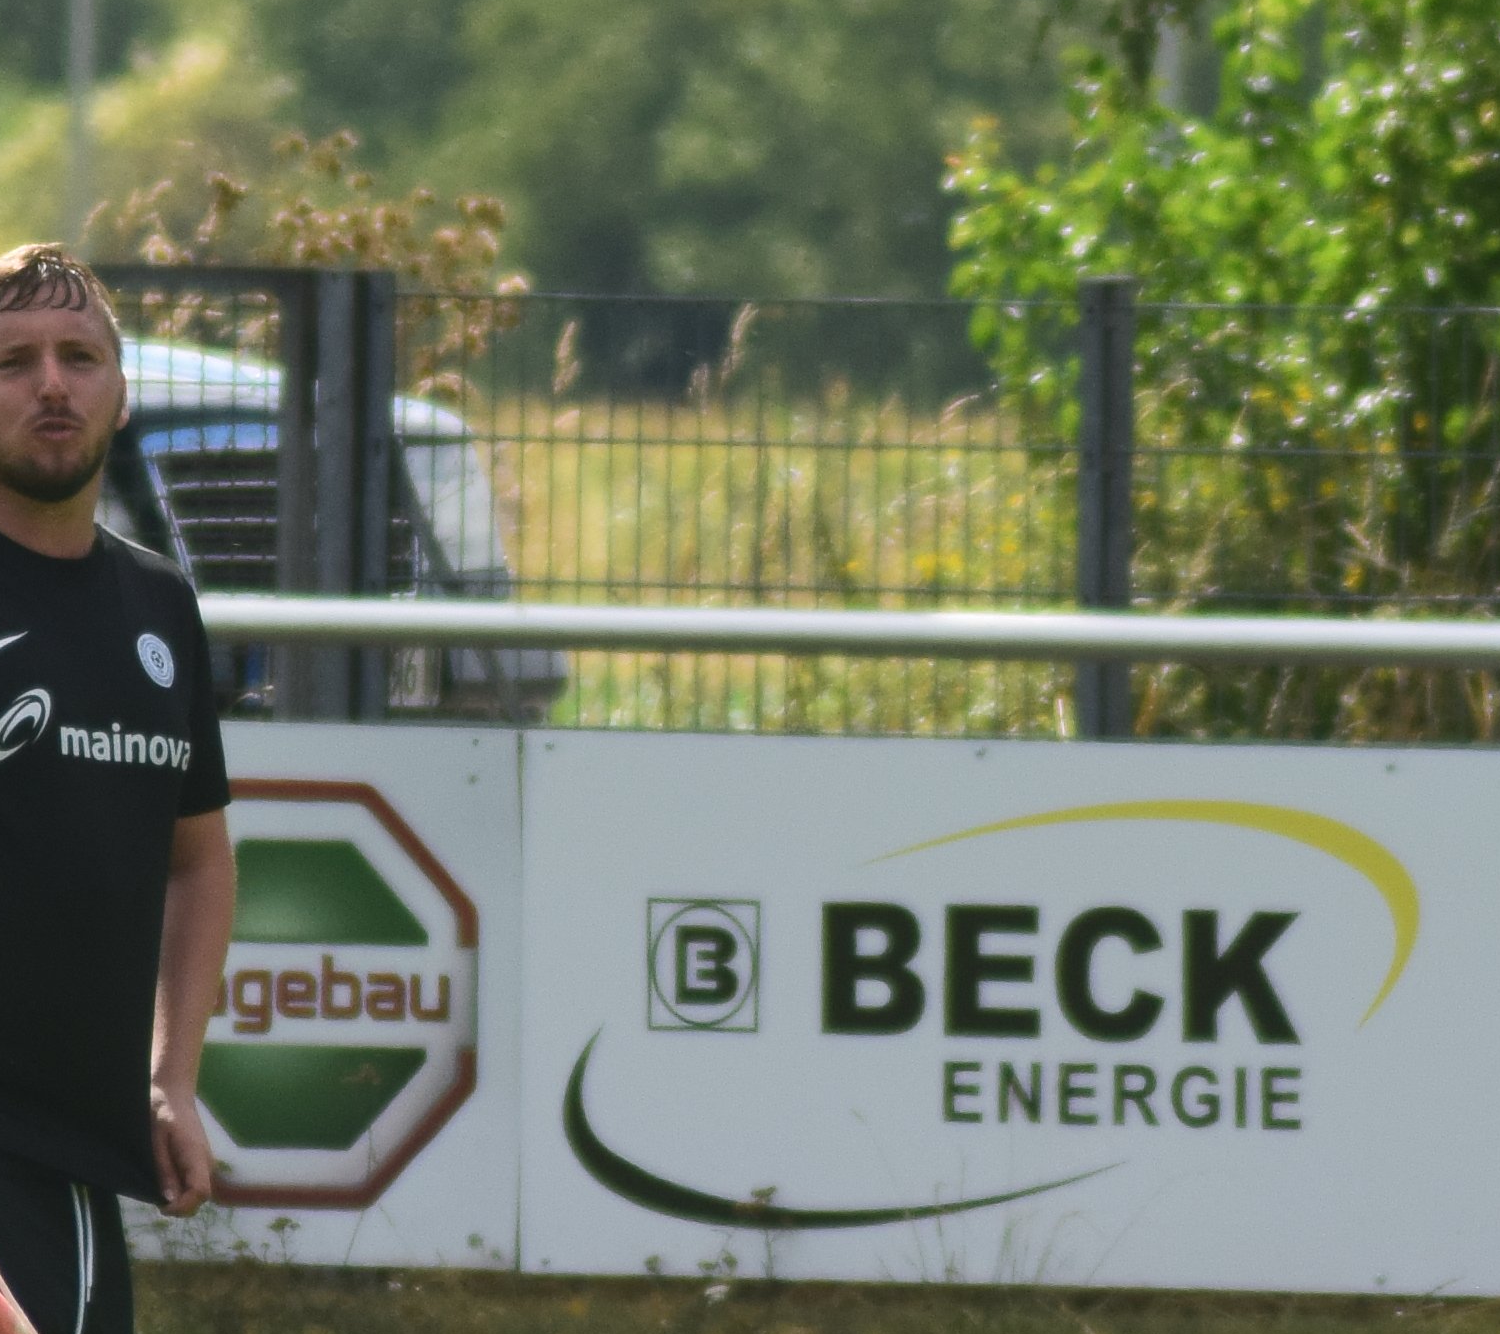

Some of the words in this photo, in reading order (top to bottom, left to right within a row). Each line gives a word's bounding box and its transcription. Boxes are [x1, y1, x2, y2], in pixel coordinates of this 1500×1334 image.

[60, 722, 191, 771] mainova
[193, 953, 450, 1034] gebau
[821, 901, 1301, 1045] BECK
[942, 1061, 1302, 1130] ENERGIE
